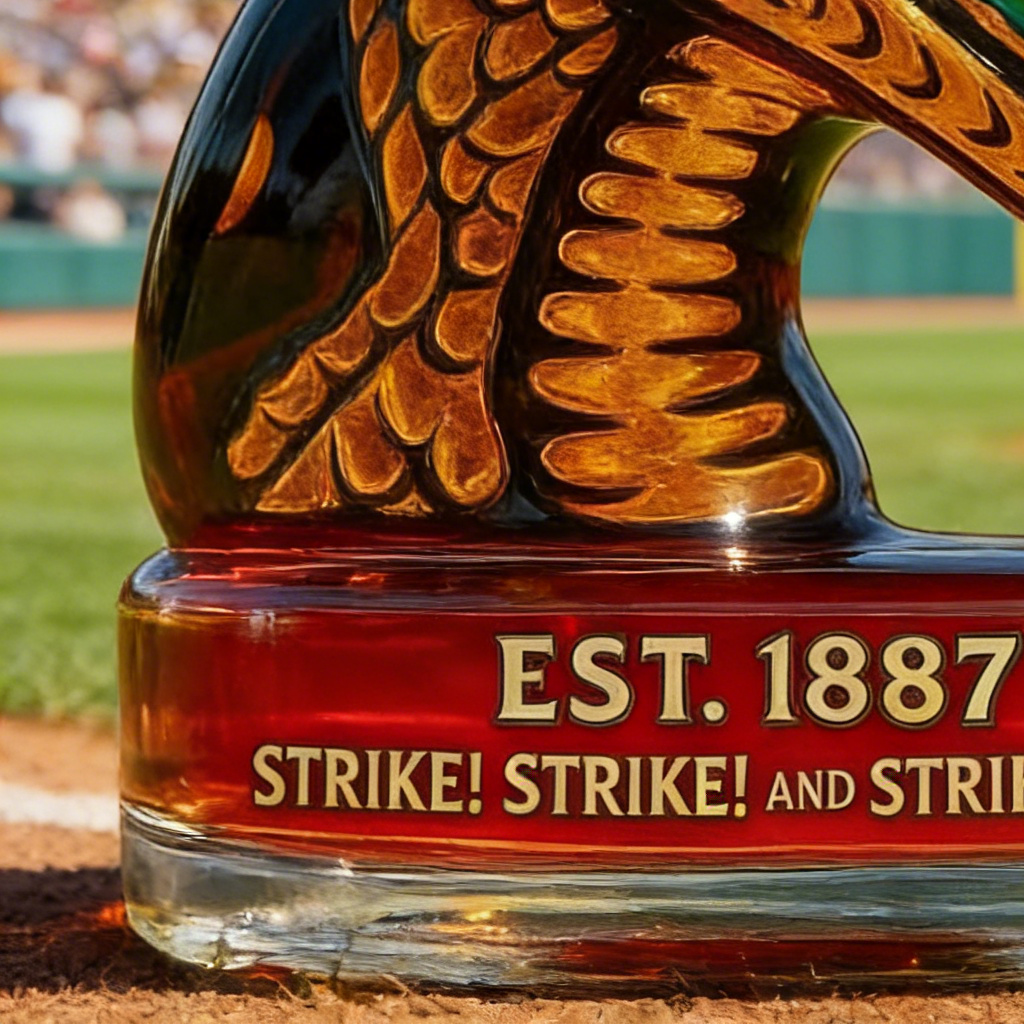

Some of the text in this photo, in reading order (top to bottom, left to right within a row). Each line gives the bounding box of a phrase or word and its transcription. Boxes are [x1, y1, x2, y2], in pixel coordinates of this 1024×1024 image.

[496, 631, 1021, 726] EST. 1887
[252, 744, 482, 815] STRIKE!
[503, 753, 748, 818] STRIKE!
[765, 769, 856, 812] AND
